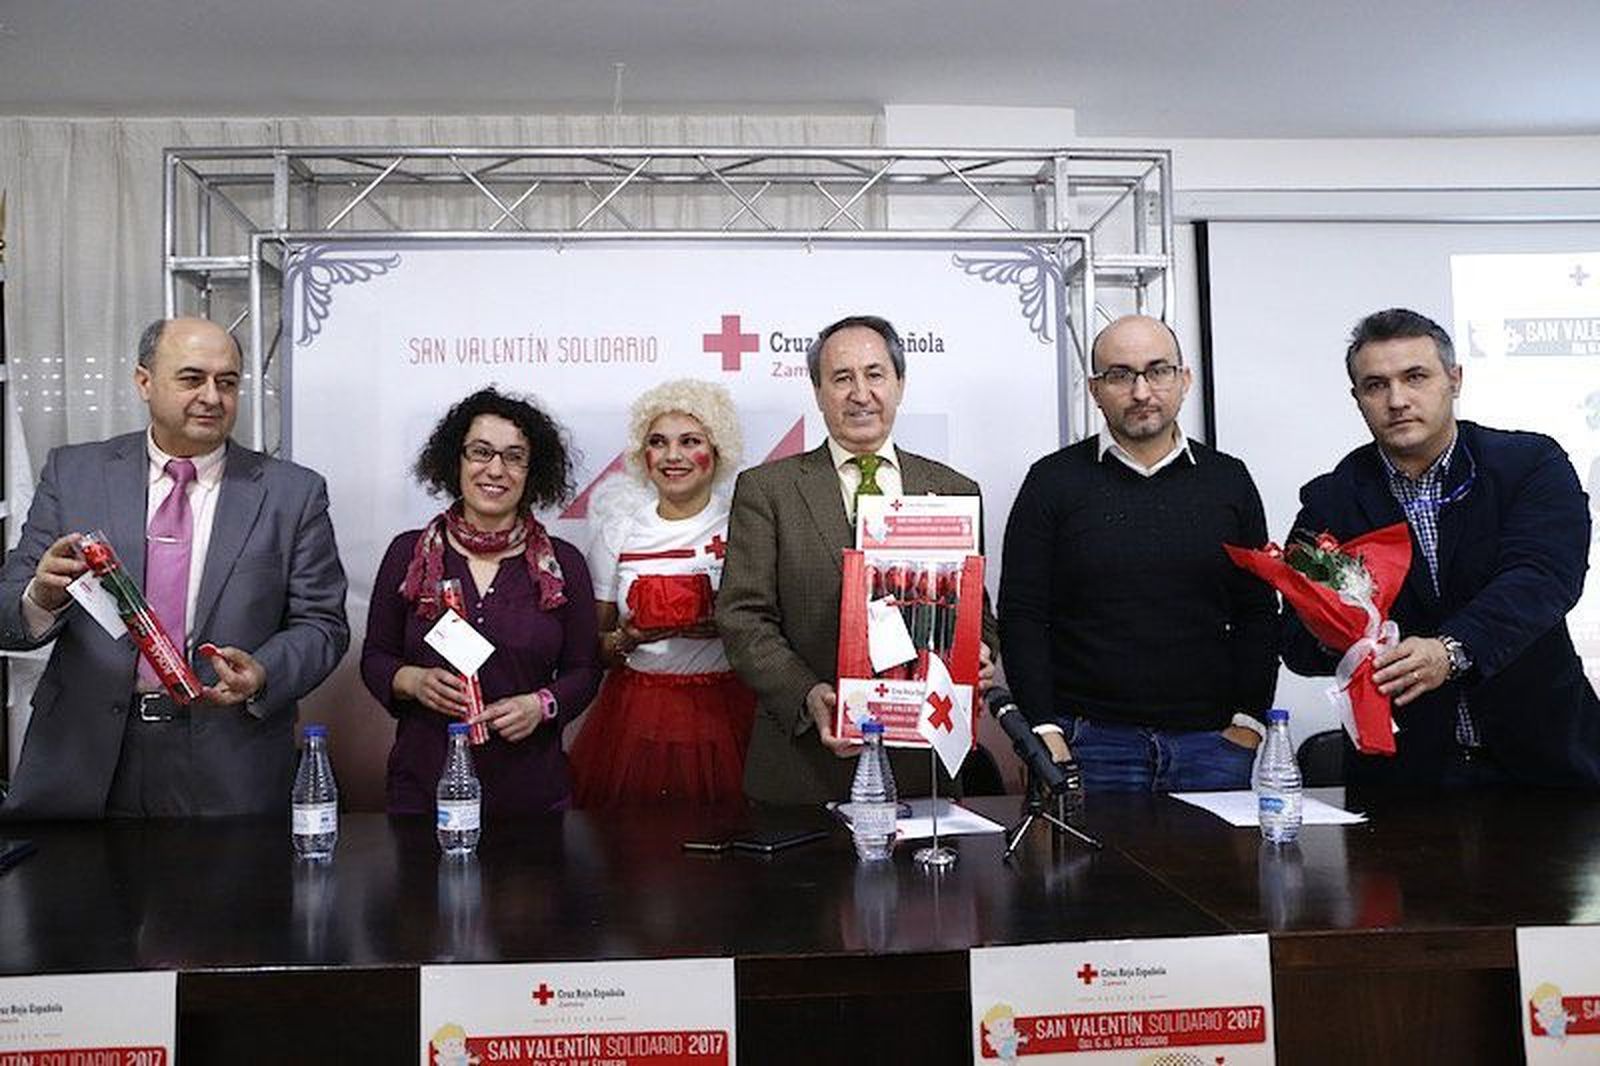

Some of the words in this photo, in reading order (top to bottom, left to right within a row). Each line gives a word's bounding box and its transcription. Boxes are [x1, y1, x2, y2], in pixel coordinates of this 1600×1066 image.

[409, 337, 446, 365] SAN
[456, 333, 548, 365] VALENTÍN
[558, 335, 658, 364] SOLIDARIO
[769, 332, 812, 353] Cruz
[898, 333, 945, 353] añola
[771, 362, 810, 377] Zam
[557, 989, 575, 998] Cruz
[576, 988, 593, 999] Roja
[1036, 1019, 1067, 1039] SAN
[1070, 1012, 1143, 1037] VALENTÍN
[1149, 1011, 1223, 1034] SOLIDARIO
[1226, 1009, 1261, 1030] 2017
[126, 1050, 162, 1066] 2017
[487, 1040, 521, 1061] SAN
[525, 1035, 602, 1059] VALENTÍN
[606, 1035, 683, 1056] SOLIDARIO
[688, 1034, 725, 1055] 2017
